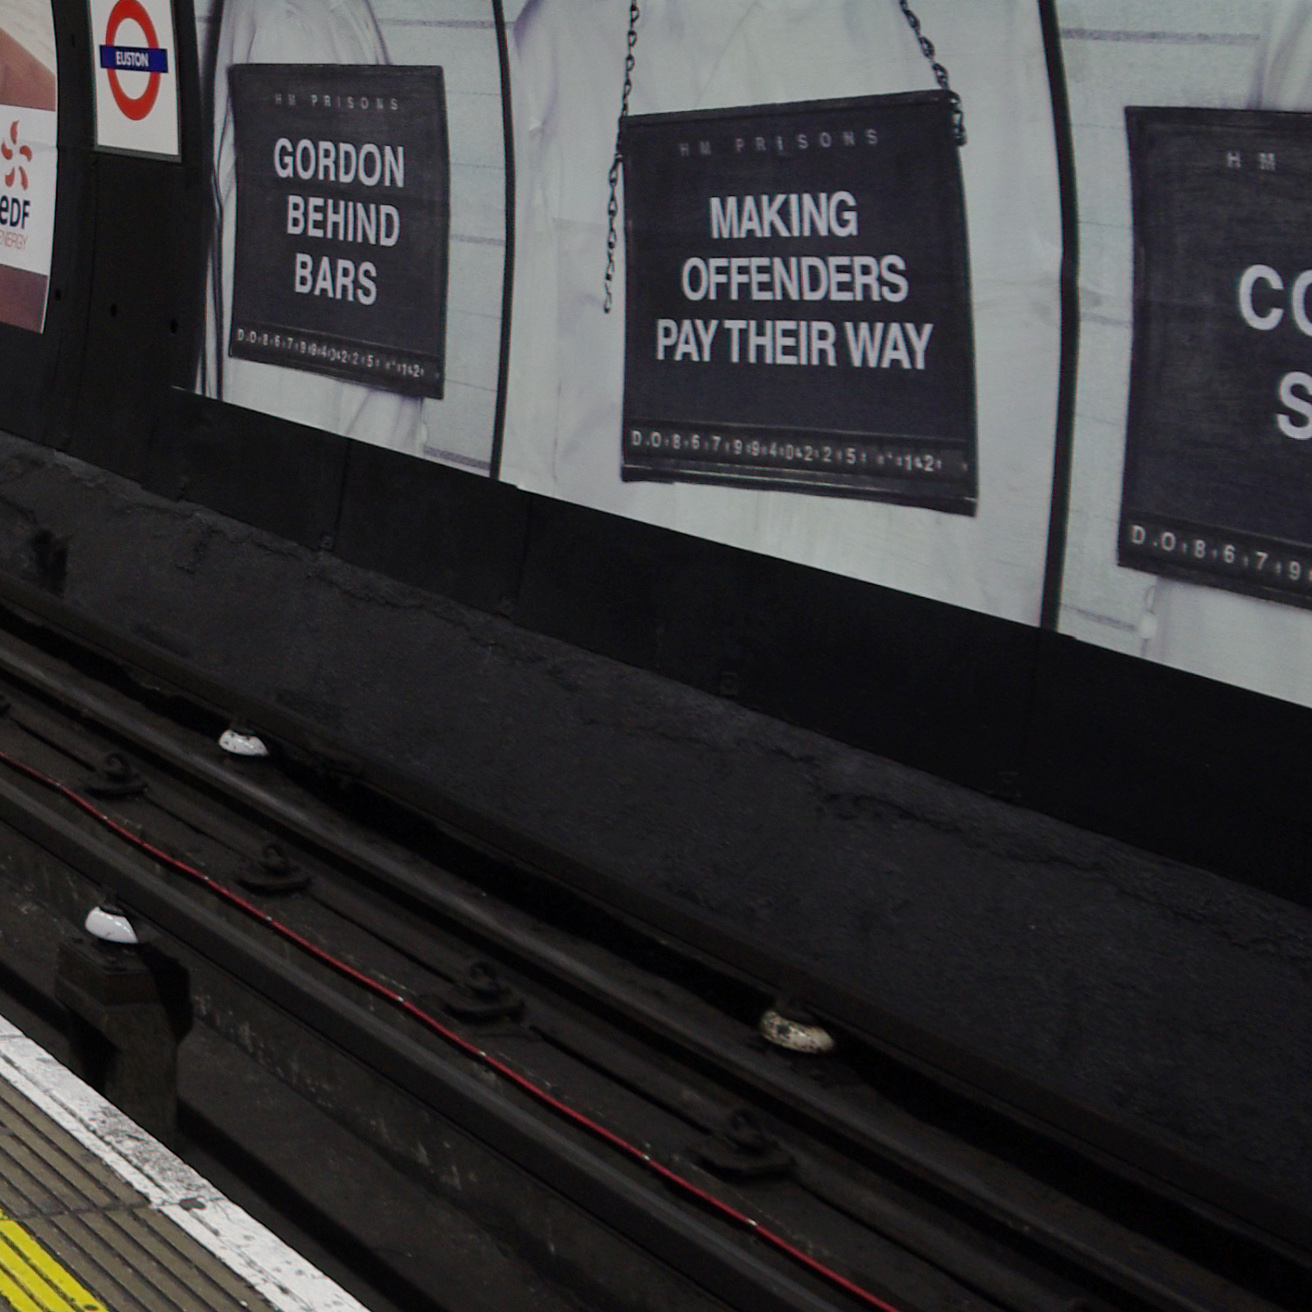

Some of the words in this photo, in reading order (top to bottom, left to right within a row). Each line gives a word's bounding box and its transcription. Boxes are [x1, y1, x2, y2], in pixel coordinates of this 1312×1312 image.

[116, 51, 150, 68] EUSTON
[275, 93, 297, 107] HM
[310, 93, 400, 111] PRISONS
[274, 137, 405, 187] GORDON
[679, 141, 712, 157] HM
[735, 128, 879, 152] PRISONS
[1226, 150, 1276, 171] HM
[287, 194, 401, 247] BEHIND
[709, 190, 859, 239] MAKING
[294, 252, 377, 305] BARS
[681, 254, 910, 303] OFFENDERS
[656, 318, 719, 363] PAY
[723, 319, 837, 367] THEIR
[843, 320, 935, 371] WAY
